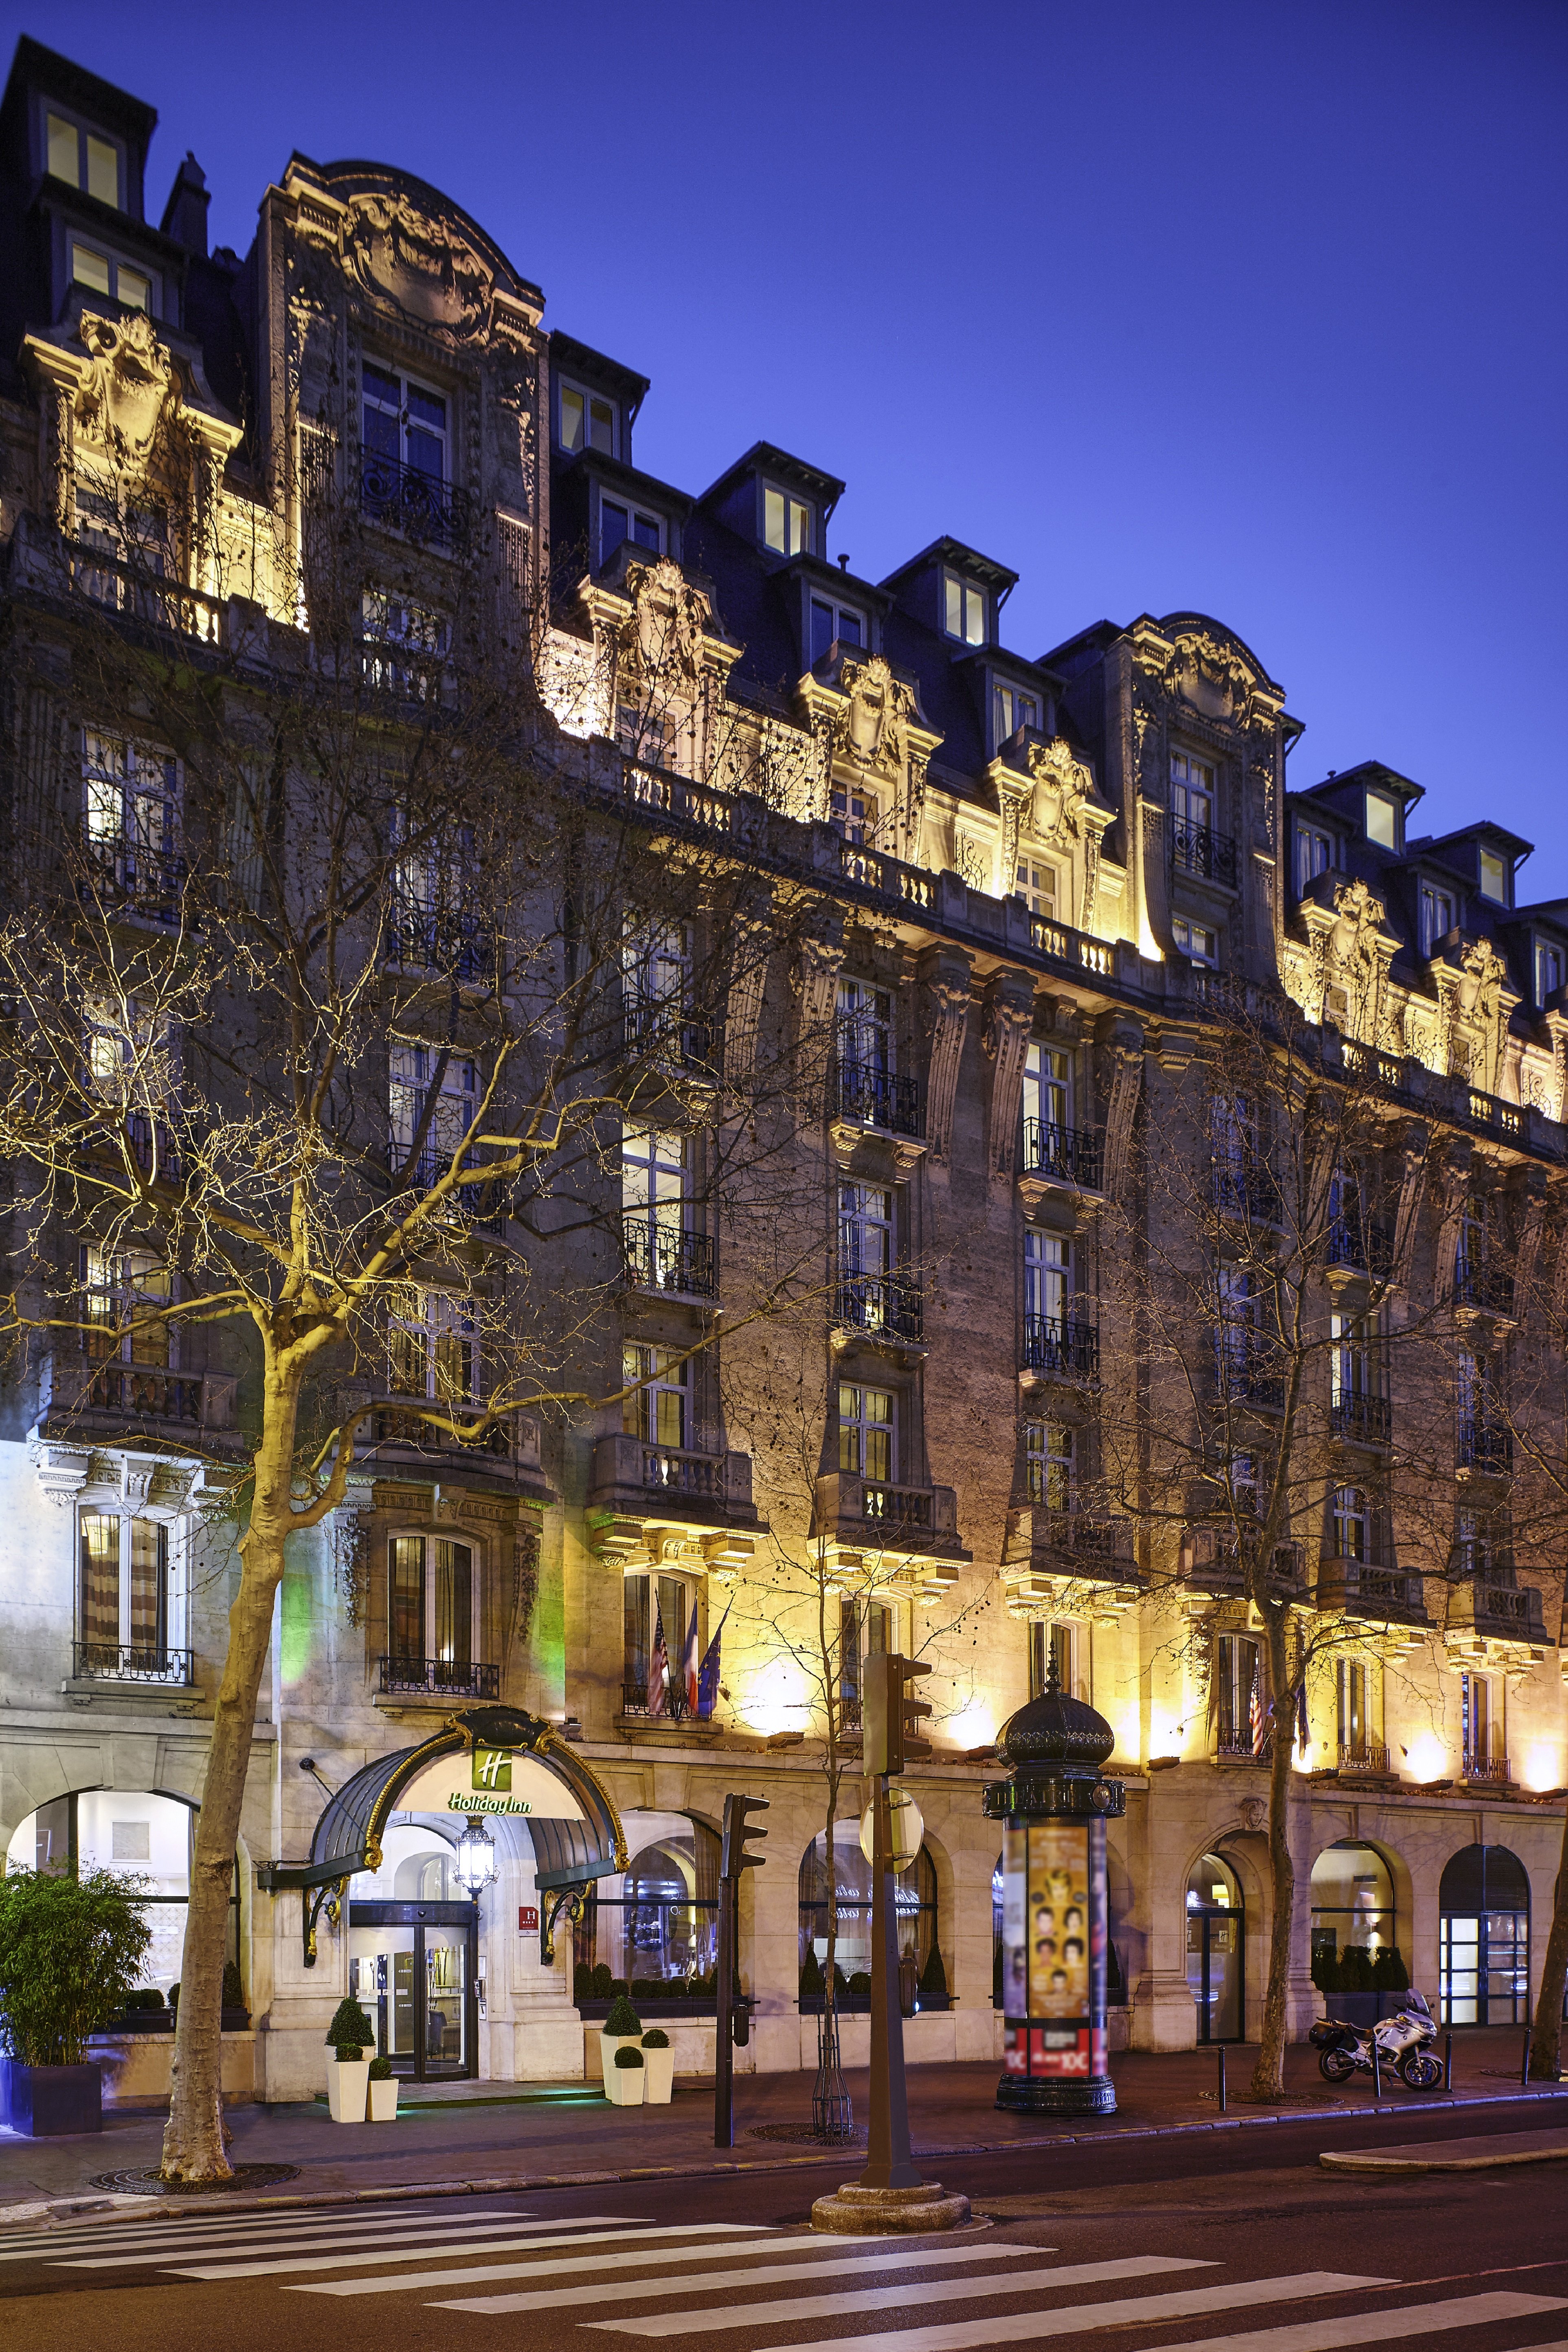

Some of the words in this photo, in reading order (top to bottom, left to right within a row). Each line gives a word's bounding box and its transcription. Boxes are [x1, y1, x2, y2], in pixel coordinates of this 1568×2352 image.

[478, 1751, 512, 1787] H
[449, 1793, 508, 1815] Holiday
[509, 1796, 532, 1813] Inn
[527, 1911, 536, 1920] H
